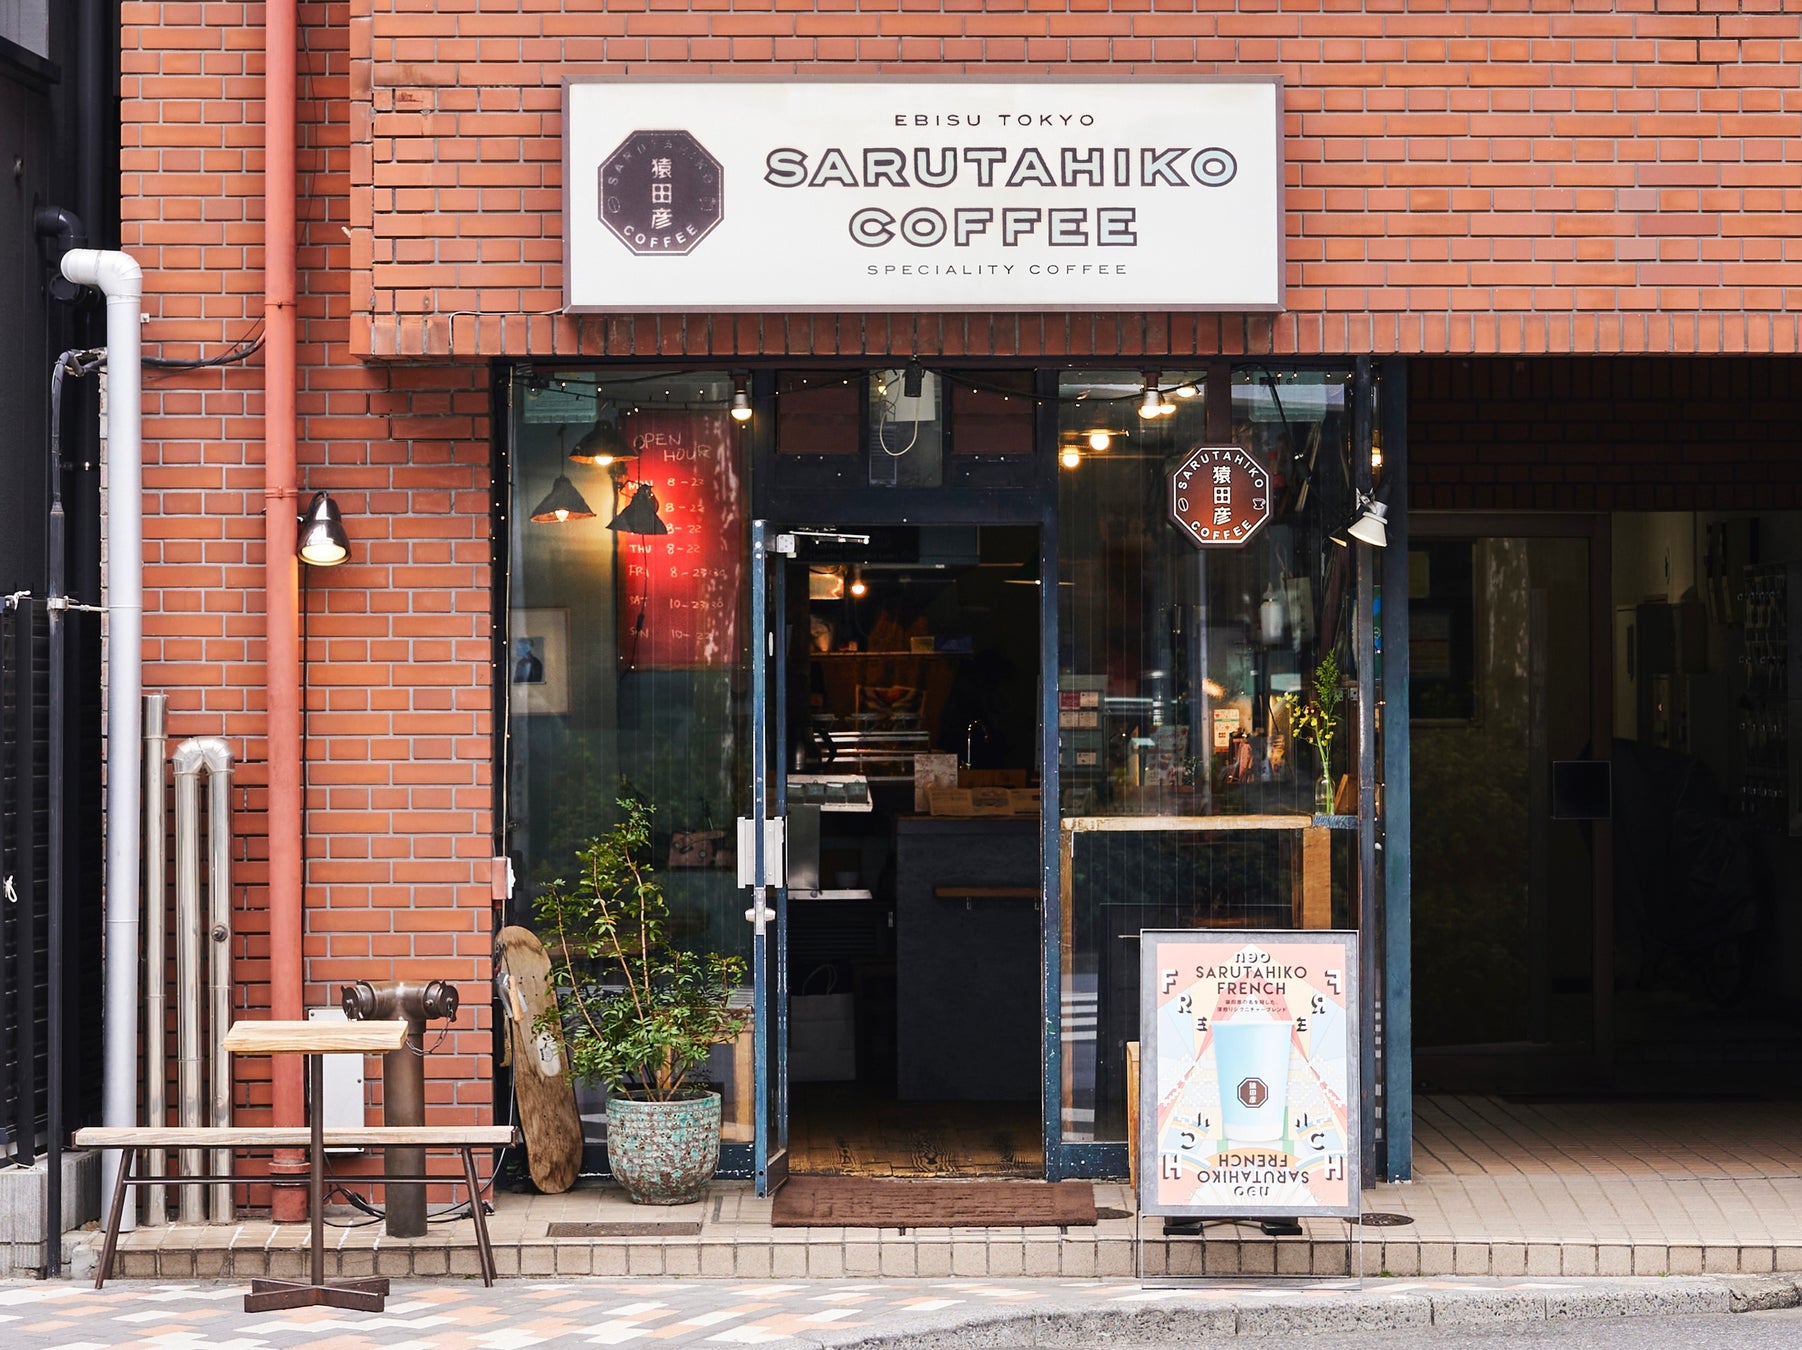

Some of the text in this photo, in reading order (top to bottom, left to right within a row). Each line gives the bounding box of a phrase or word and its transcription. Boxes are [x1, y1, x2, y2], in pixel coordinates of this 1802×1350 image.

[894, 114, 1095, 127] EBISU TOKYO
[763, 146, 1238, 189] SARUTAHIKO
[650, 157, 673, 230] 猿田彦
[848, 206, 1137, 248] COFFEE
[623, 223, 699, 248] COFFEE
[867, 264, 1127, 276] SPECIALITY COFFEE
[633, 432, 681, 450] OPEN
[1178, 450, 1264, 490] SARUTAHIKO
[1212, 466, 1232, 526] 猿田彦
[1191, 520, 1252, 540] COFFEE
[629, 544, 652, 553] THU
[629, 564, 650, 577] FRI
[630, 626, 649, 639] SN
[1196, 965, 1307, 979] SARUTAHIKO
[1217, 982, 1286, 995] FRENCH
[1218, 1154, 1288, 1167] FRENCH
[1197, 1170, 1309, 1184] SARUTAHIKO
